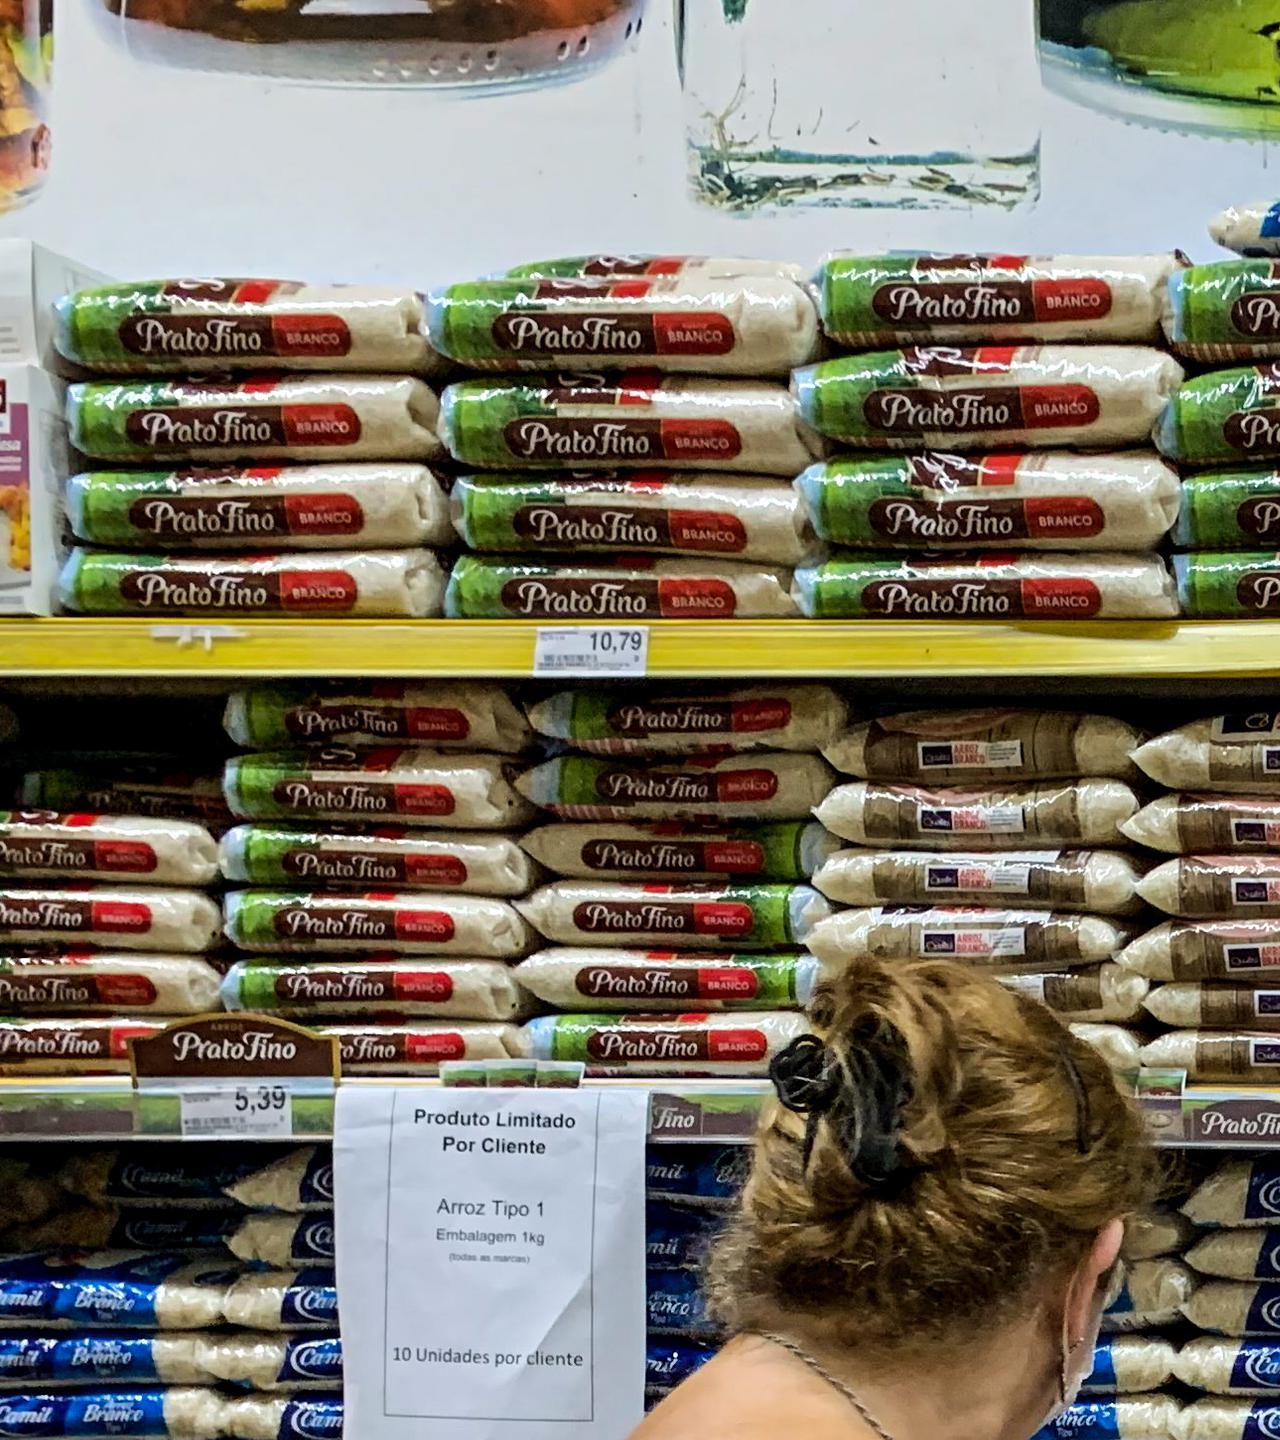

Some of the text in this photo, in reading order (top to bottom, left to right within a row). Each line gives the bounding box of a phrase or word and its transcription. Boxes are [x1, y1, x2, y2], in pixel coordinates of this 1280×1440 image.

[589, 631, 642, 654] 10,79
[234, 1086, 287, 1114] 5,39
[414, 1109, 576, 1129] Produto Limitado
[442, 1137, 546, 1155] Por Cliente
[437, 1199, 544, 1218] Arroz Tipo 1
[436, 1228, 544, 1246] Embalagem 1kg
[392, 1347, 583, 1367] 10 Unidades por cliente
